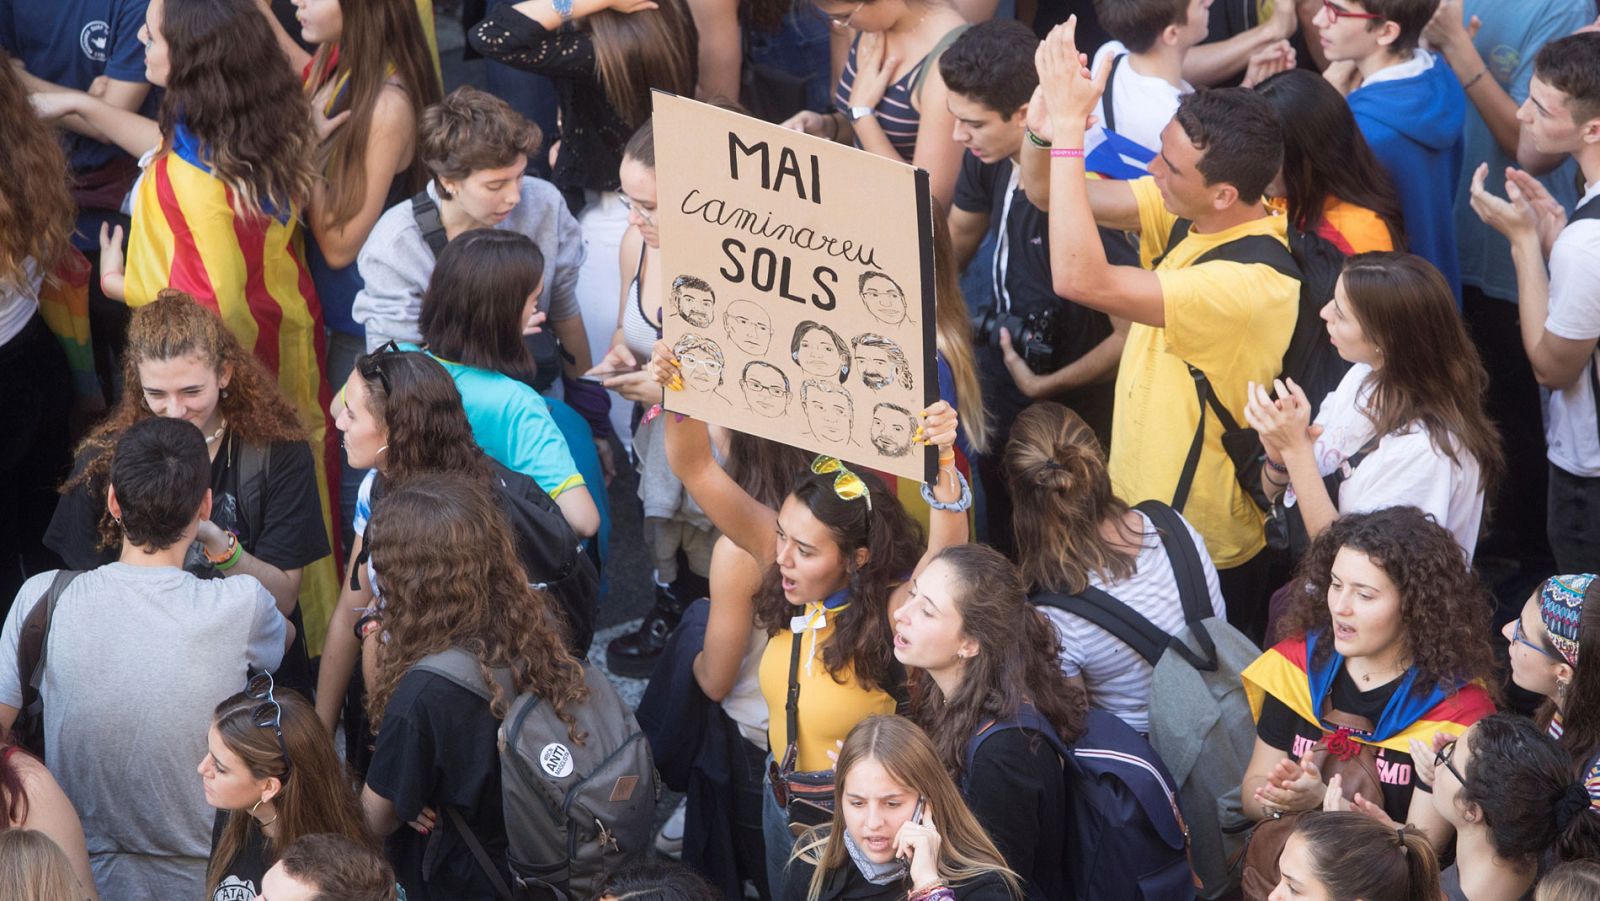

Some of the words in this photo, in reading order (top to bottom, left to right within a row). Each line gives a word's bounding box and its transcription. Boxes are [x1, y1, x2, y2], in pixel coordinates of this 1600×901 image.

[728, 131, 821, 204] MAI
[681, 189, 882, 270] caminareu
[720, 238, 838, 311] SOLS
[546, 745, 565, 772] ANTI
